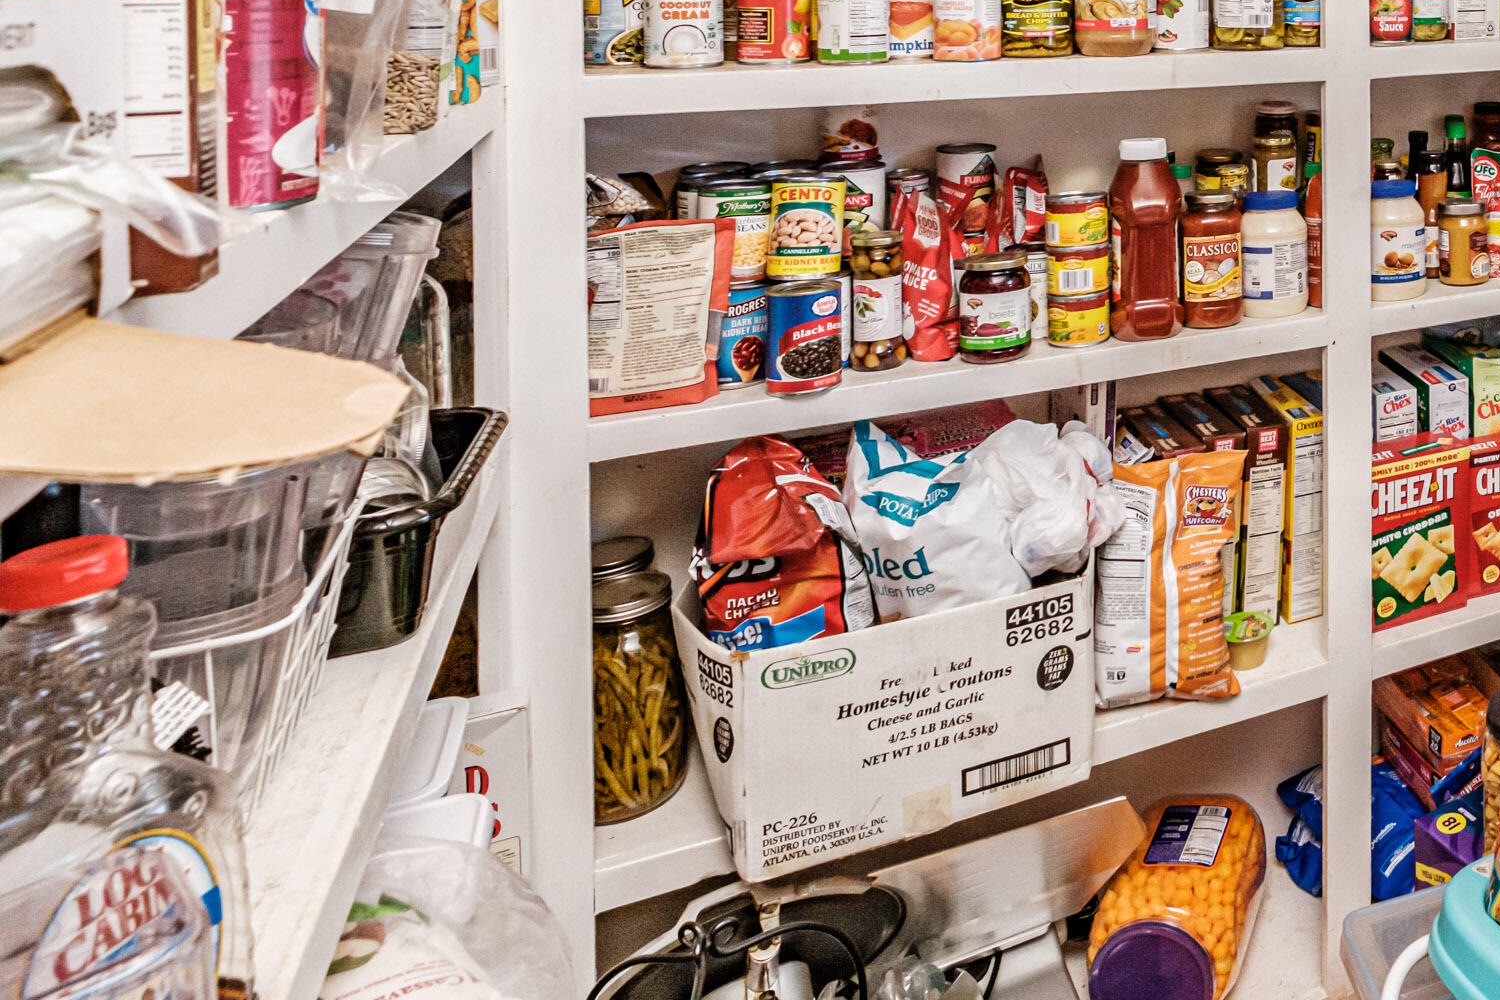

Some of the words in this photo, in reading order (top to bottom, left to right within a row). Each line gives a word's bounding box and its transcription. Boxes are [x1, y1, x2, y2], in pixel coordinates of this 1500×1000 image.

[659, 2, 711, 10] COCONUT
[662, 10, 710, 20] CREAM
[1379, 22, 1404, 32] Sauce
[1474, 165, 1496, 176] UFC
[779, 188, 832, 202] CENTO
[1187, 242, 1238, 257] CLASSICO
[732, 317, 751, 329] DARK
[793, 322, 825, 341] Black
[1393, 392, 1407, 402] Rice
[1383, 396, 1412, 415] Chex
[1446, 415, 1461, 427] Rice
[1414, 458, 1435, 468] 200%
[906, 583, 936, 598] free
[1007, 596, 1071, 628] 44105
[1006, 618, 1074, 648] 62682
[1044, 656, 1068, 668] GRAMS
[867, 711, 912, 731] Cheese
[917, 702, 940, 718] and
[946, 691, 985, 711] Garlic
[888, 728, 918, 744] 4/2.5
[920, 722, 938, 736] LB
[940, 713, 973, 731] BAGS
[861, 753, 888, 768] NET
[893, 746, 913, 760] WT
[916, 741, 931, 753] 10
[934, 736, 950, 748] LB
[953, 722, 999, 743] (4.53kg)
[1454, 735, 1480, 748] Austin
[762, 812, 818, 836] PC-226
[763, 824, 826, 847] DISTRIBUTED
[829, 820, 841, 831] BY
[763, 842, 799, 857] UNIPRO
[871, 816, 888, 827] INC.
[763, 849, 810, 868] ATLANTA,
[814, 845, 827, 854] GA
[53, 878, 183, 982] CABIN
